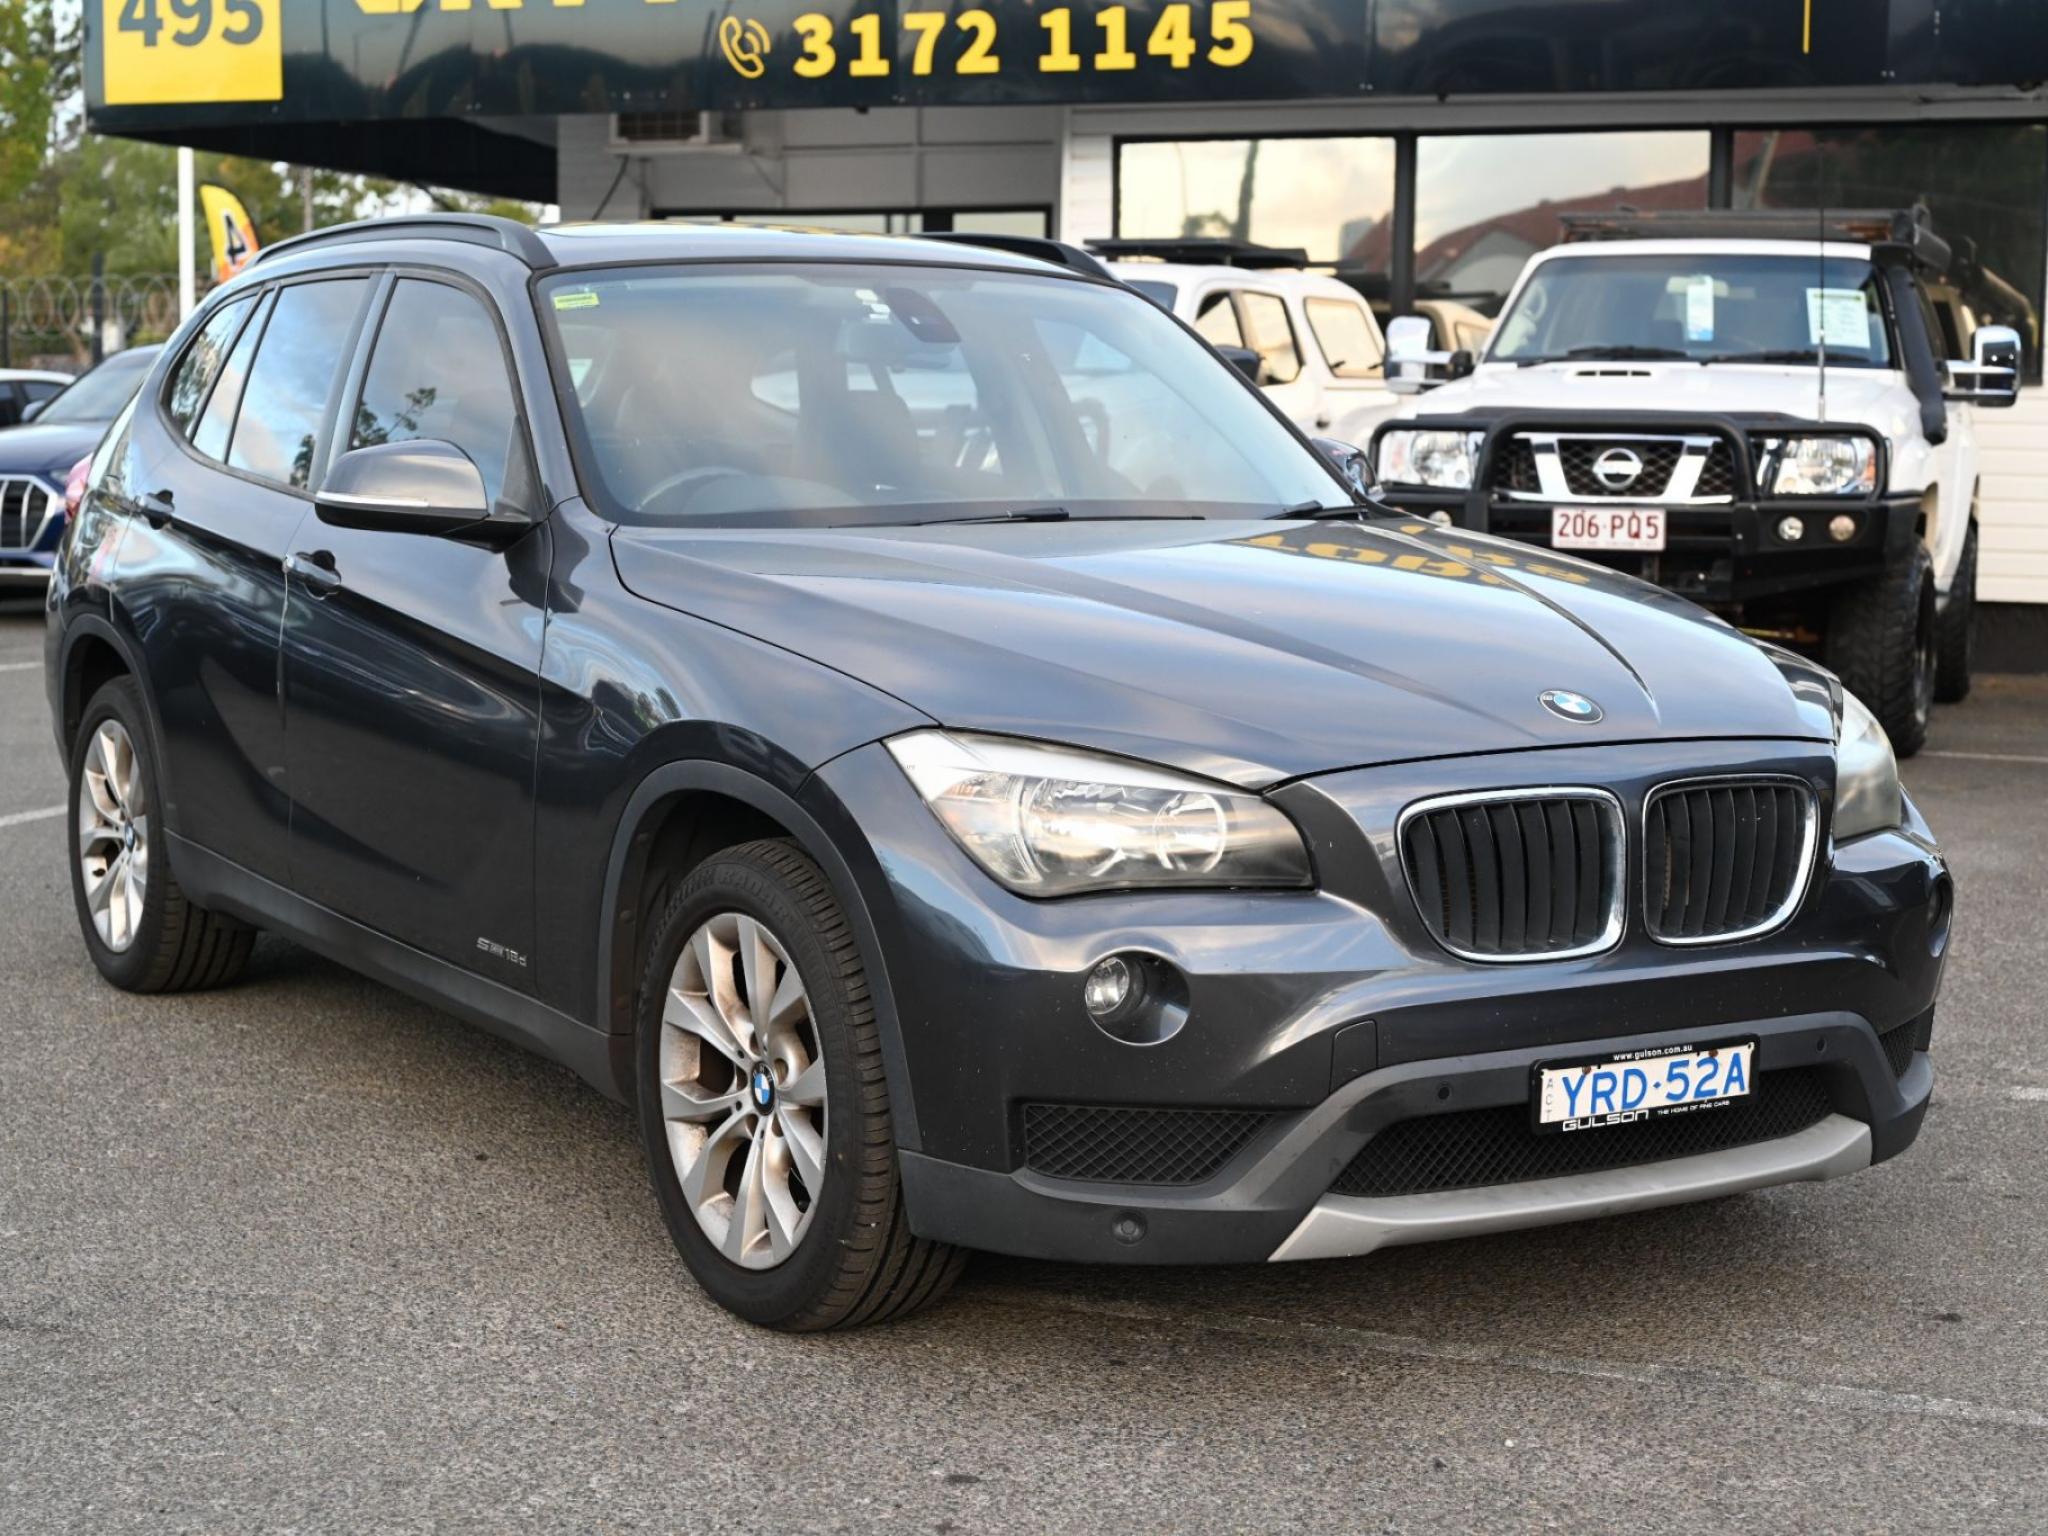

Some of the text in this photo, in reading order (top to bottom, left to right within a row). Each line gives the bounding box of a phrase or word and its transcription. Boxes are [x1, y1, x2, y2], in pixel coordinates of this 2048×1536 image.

[118, 0, 263, 47] 495
[792, 1, 1254, 78] 3172 1145
[1613, 1045, 1693, 1061] www.gulson.com.au
[1562, 1109, 1650, 1132] GULSON
[1671, 1106, 1688, 1114] HOME
